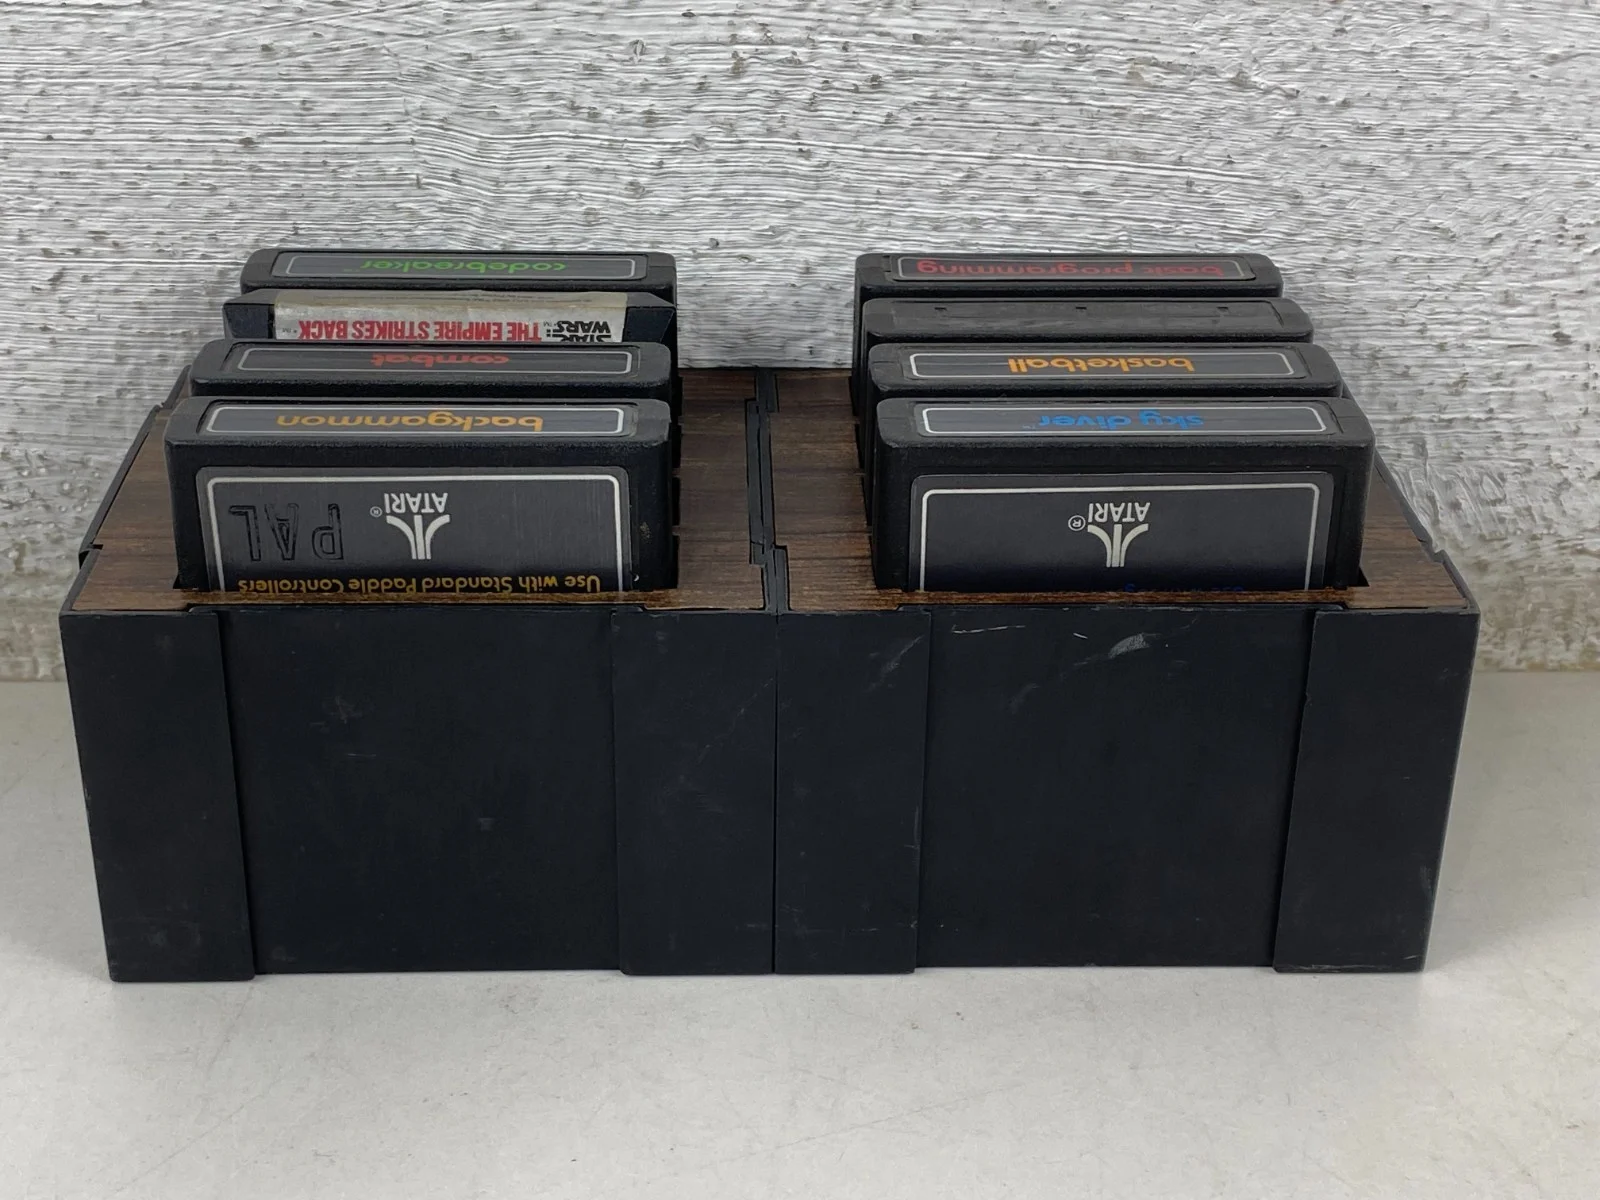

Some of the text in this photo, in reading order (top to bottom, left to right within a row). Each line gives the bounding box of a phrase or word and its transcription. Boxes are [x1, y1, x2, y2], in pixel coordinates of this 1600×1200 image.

[360, 260, 567, 273] codebreaker
[917, 261, 1133, 277] programming
[299, 320, 542, 343] THE EMPIRE STRIKES BACK
[546, 321, 611, 333] WARS
[370, 352, 510, 368] combat
[1008, 356, 1195, 373] basketball
[276, 411, 543, 432] backgammon
[1138, 408, 1204, 429] sky
[228, 502, 344, 562] PAL
[238, 575, 601, 594] Use with Standard Paddle Controllers
